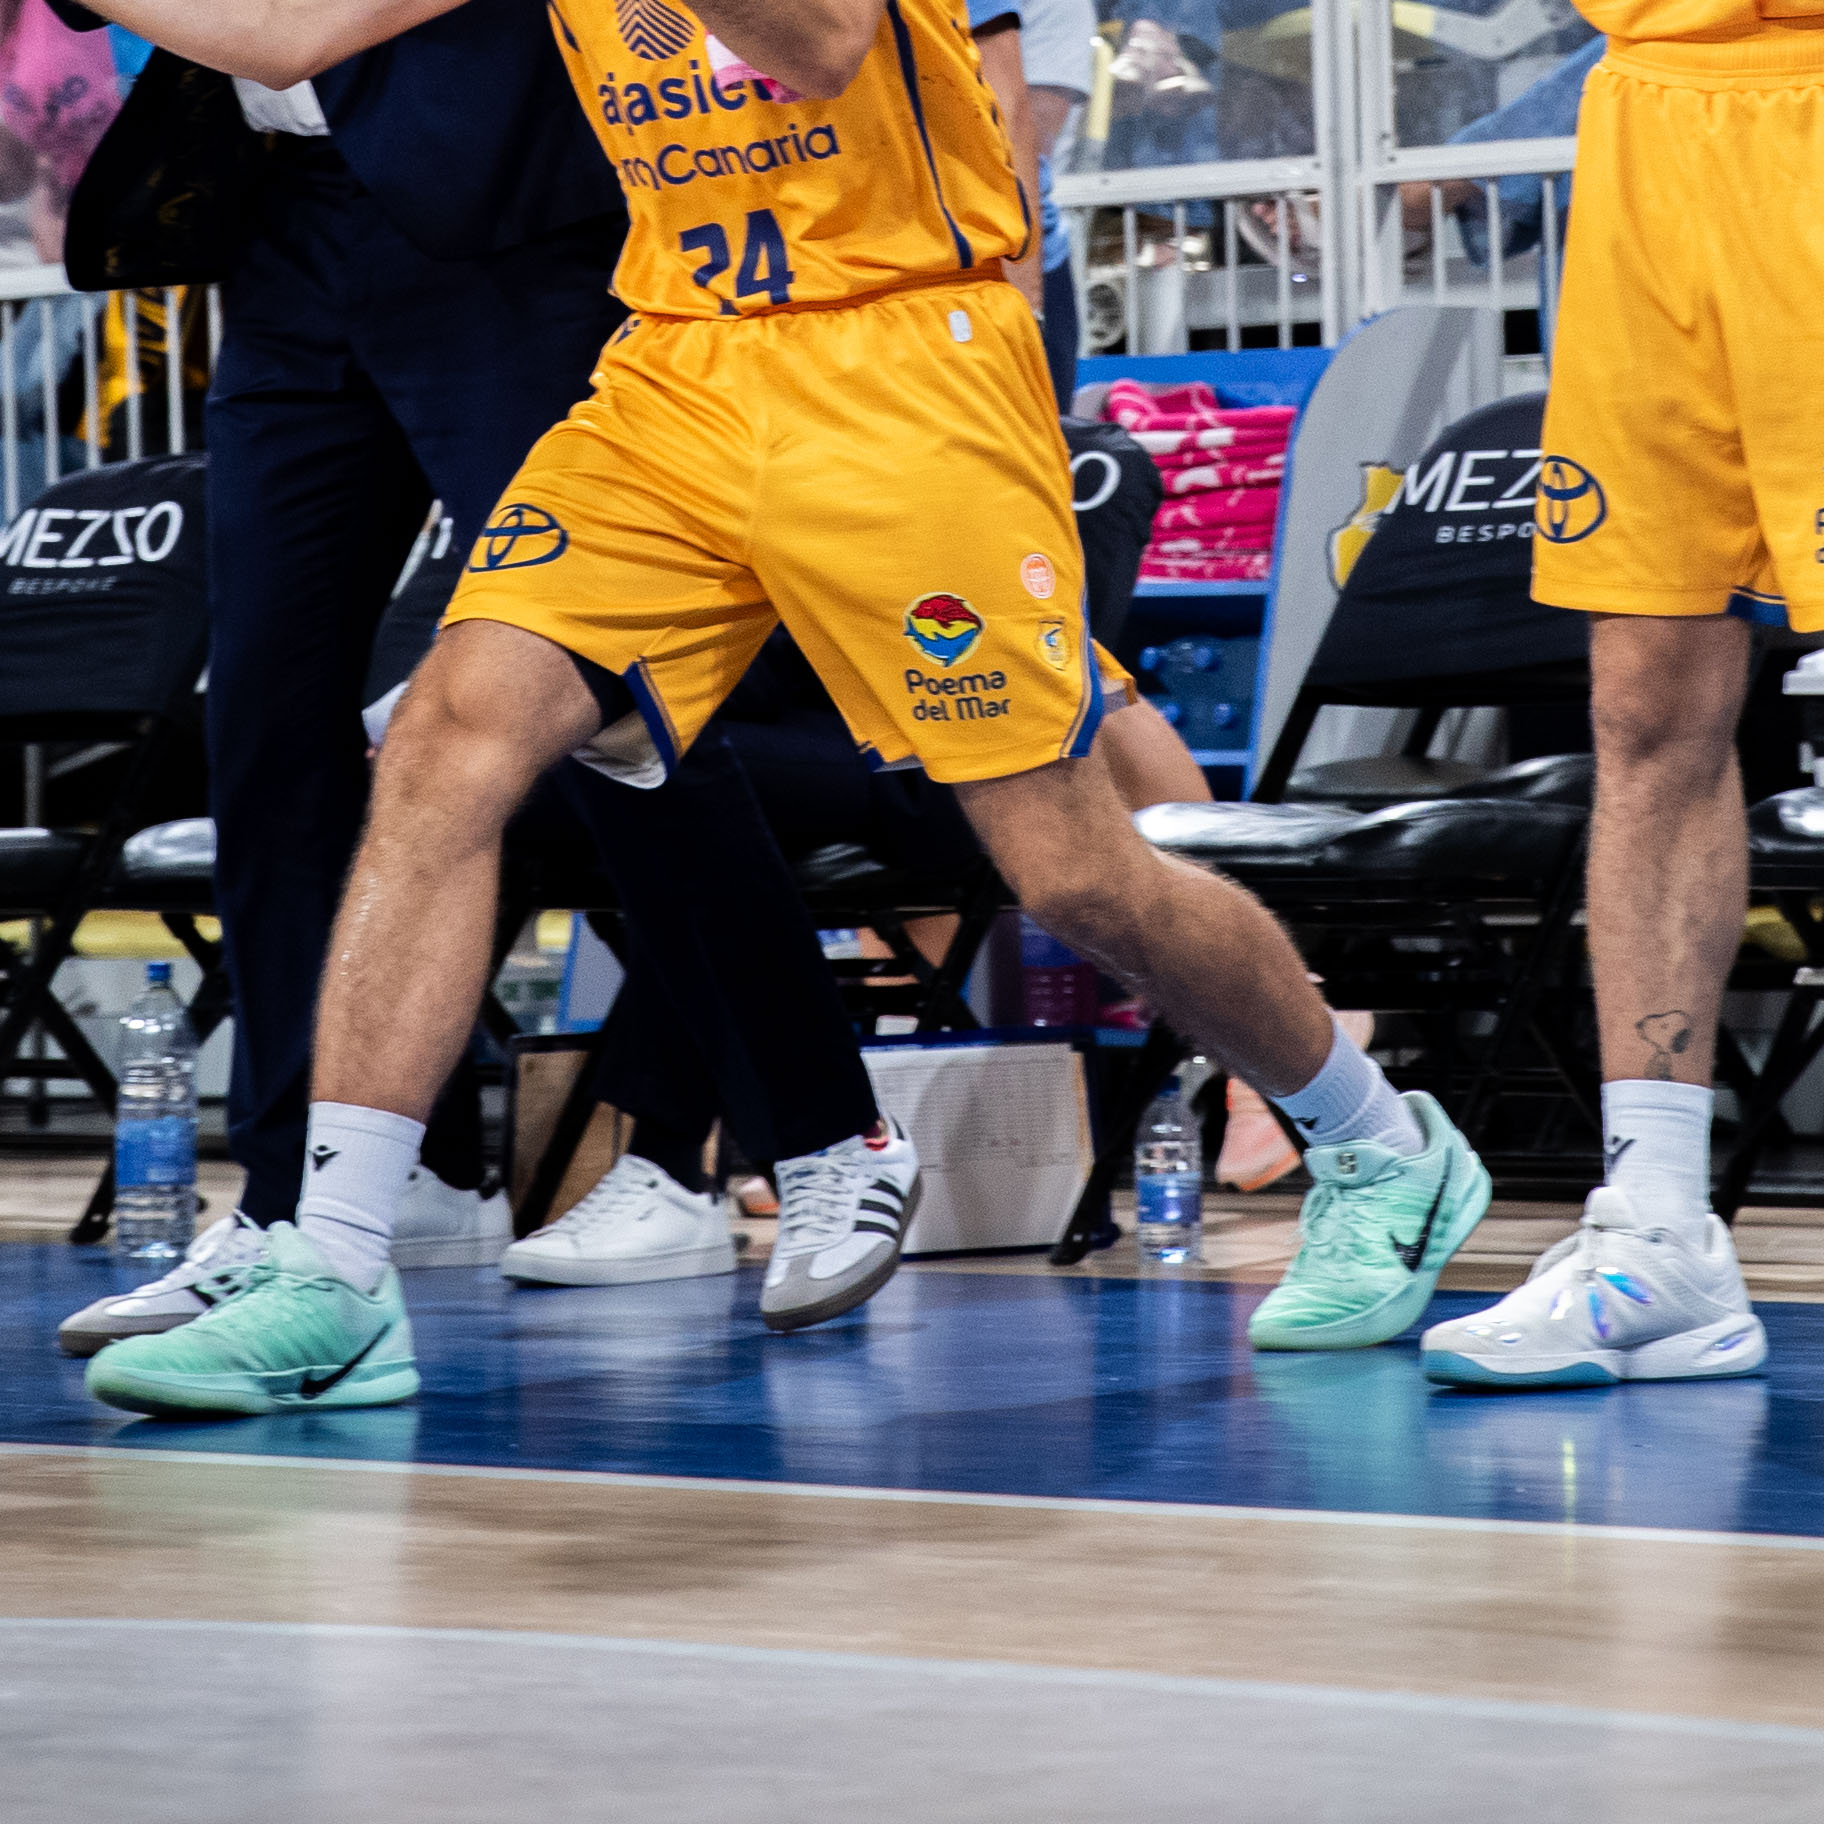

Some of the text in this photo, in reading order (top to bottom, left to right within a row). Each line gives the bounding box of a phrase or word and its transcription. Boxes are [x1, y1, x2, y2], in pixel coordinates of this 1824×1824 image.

[679, 207, 794, 315] 24
[1381, 448, 1544, 515] MEZ
[1435, 521, 1537, 544] BESPO
[904, 668, 1007, 695] Poema
[912, 696, 1011, 721] del Mar
